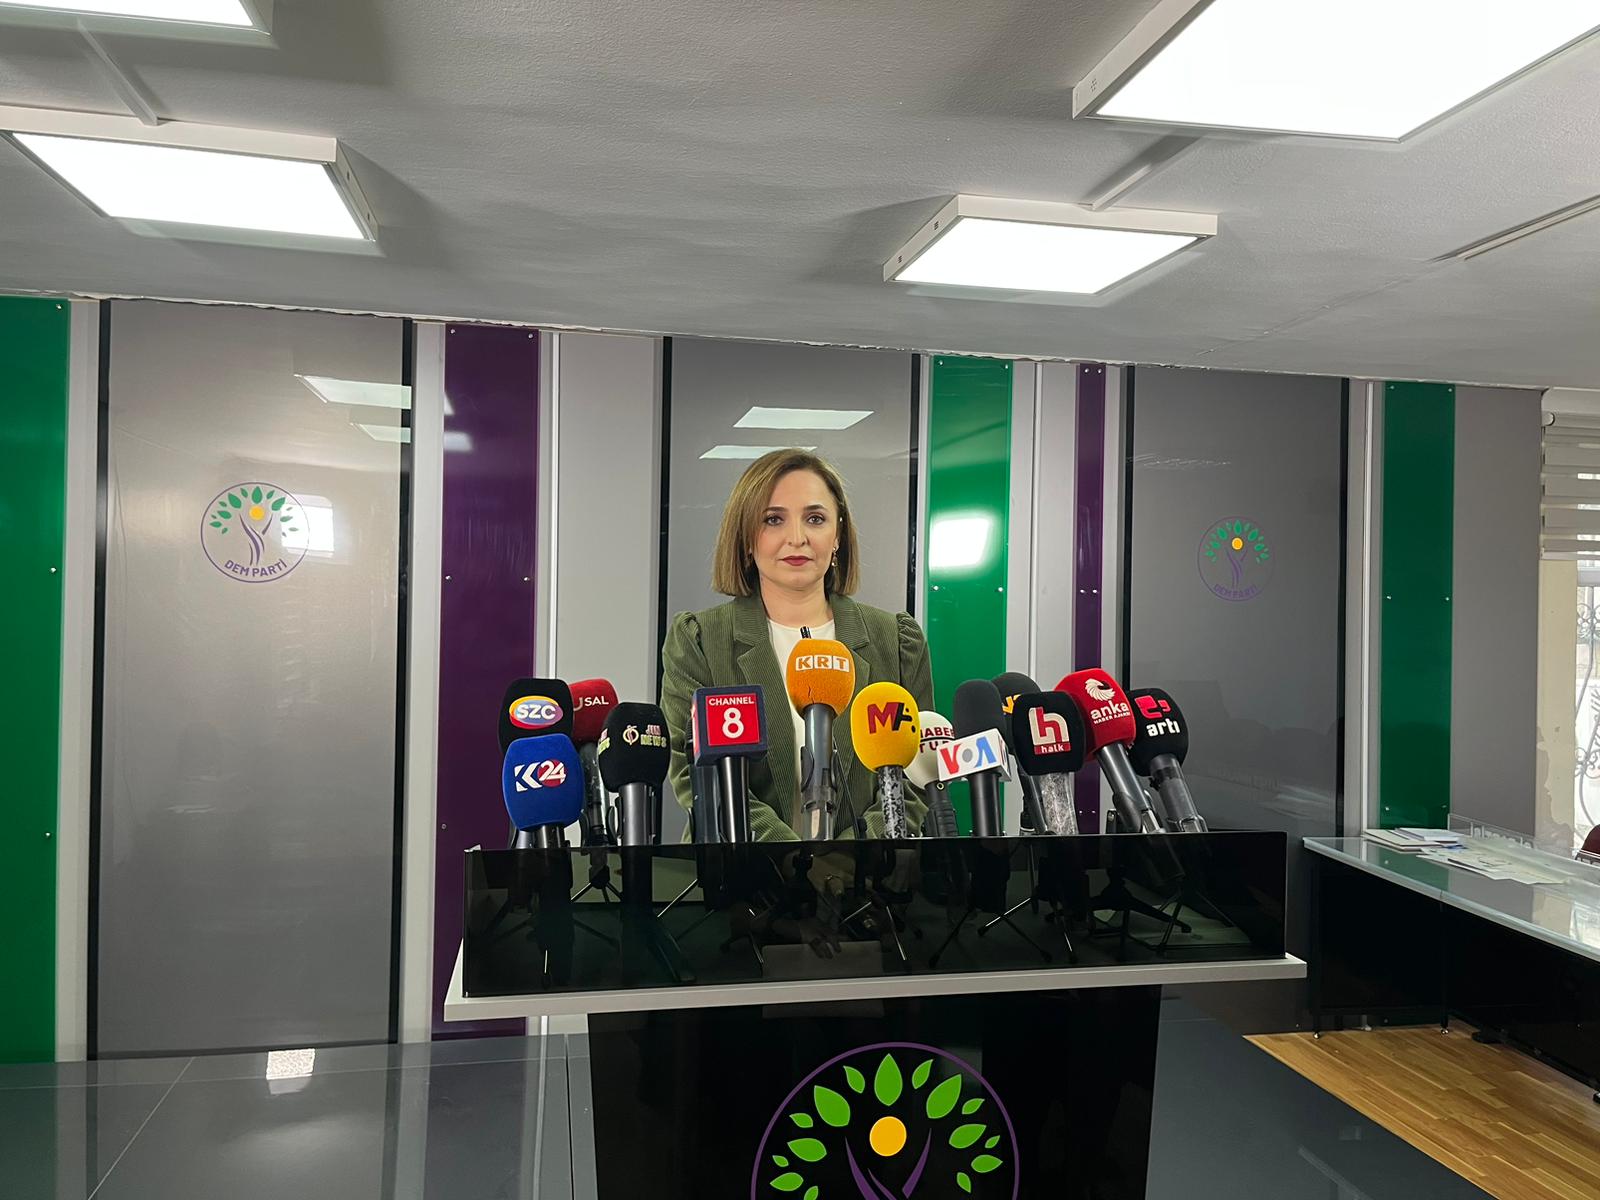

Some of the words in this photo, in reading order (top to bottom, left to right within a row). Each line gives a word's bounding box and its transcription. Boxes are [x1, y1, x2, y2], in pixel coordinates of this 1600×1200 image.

[224, 559, 250, 577] DEM
[797, 656, 848, 670] KRT
[708, 696, 755, 706] CHANNEL
[516, 704, 556, 720] SZC
[1090, 700, 1130, 720] anka
[722, 707, 745, 739] 8
[919, 740, 949, 754] TU
[1041, 743, 1065, 754] halk
[940, 736, 997, 775] VOA
